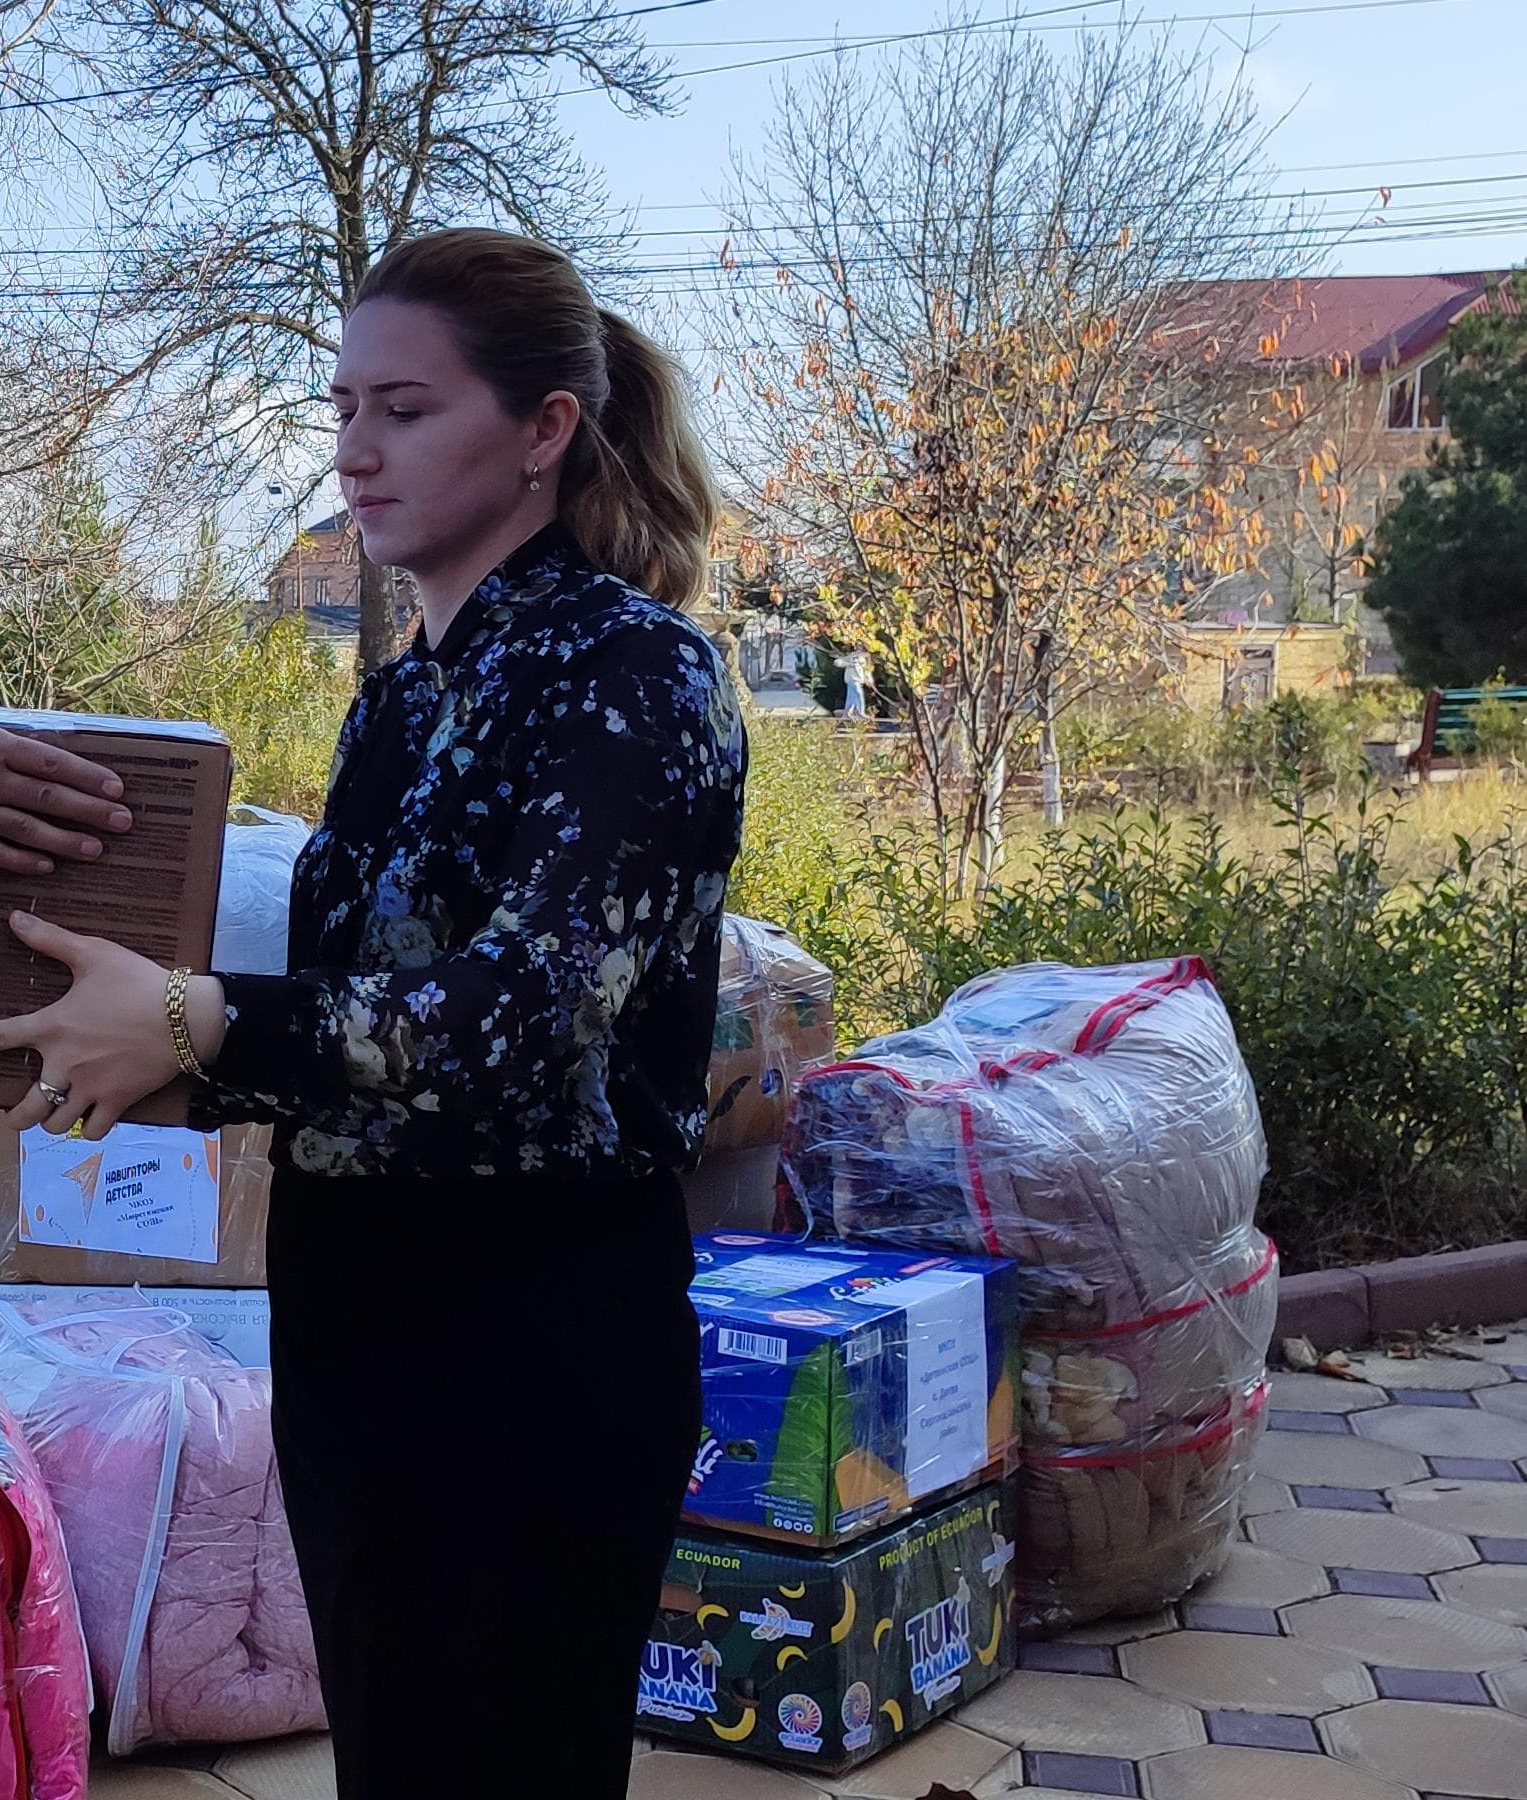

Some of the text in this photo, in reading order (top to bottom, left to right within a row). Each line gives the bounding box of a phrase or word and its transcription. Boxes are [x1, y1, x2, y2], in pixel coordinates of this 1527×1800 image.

[105, 1157, 160, 1185] НАВИГАТОРЫ
[106, 1182, 142, 1205] ДЕТСТВА
[879, 1507, 983, 1571] PRODUCT OF ECUADOR
[676, 1549, 741, 1569] ECUADOR
[908, 1599, 969, 1664] TUKI
[641, 1642, 715, 1690] UKI
[912, 1642, 969, 1692] BANANA
[639, 1679, 716, 1710] ANANA
